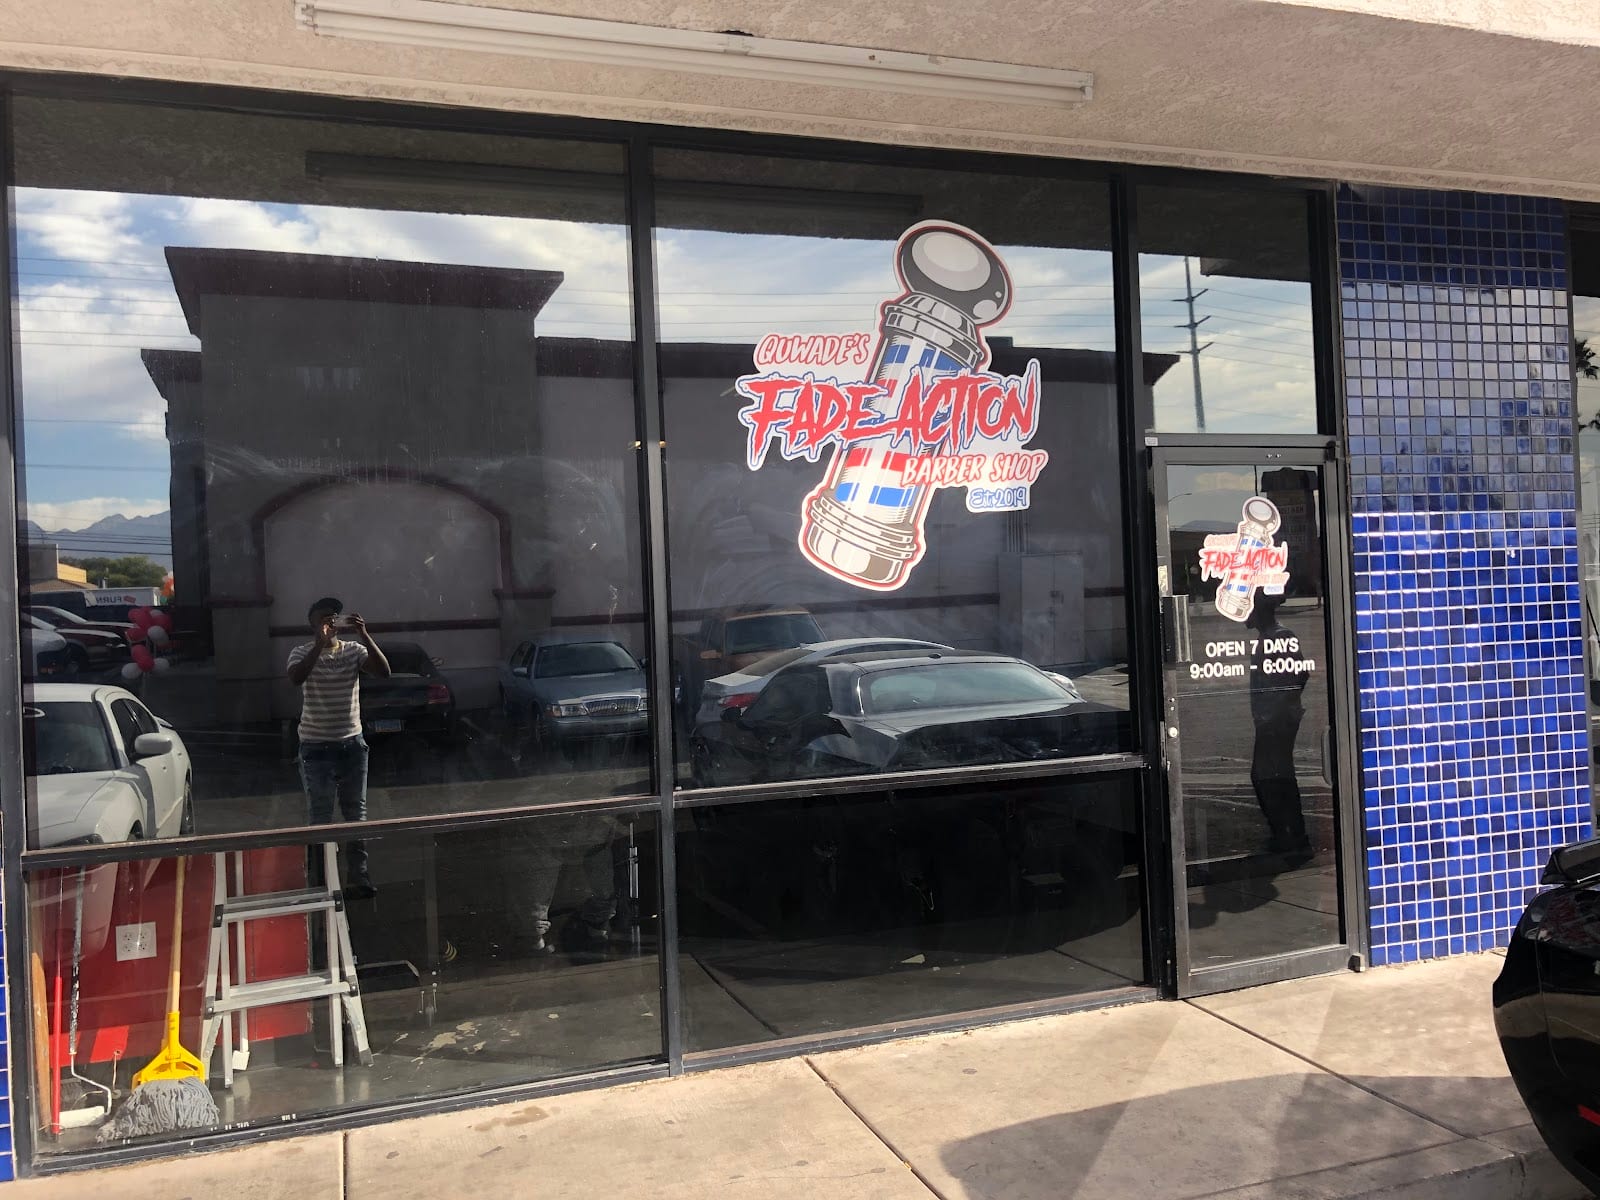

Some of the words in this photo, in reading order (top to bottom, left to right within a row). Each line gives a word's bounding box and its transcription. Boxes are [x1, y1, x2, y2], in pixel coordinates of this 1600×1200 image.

[740, 371, 892, 464] FADE
[892, 358, 1040, 455] ACTION
[900, 454, 987, 487] BARBER
[989, 452, 1046, 482] SHOP
[1203, 551, 1241, 574] FADE
[1242, 547, 1286, 571] ACTION
[1205, 640, 1245, 658] OPEN
[1249, 639, 1259, 655] 7
[1263, 637, 1300, 654] DAYS
[1189, 661, 1245, 679] 9:00am
[1262, 657, 1316, 676] 6:00pm
